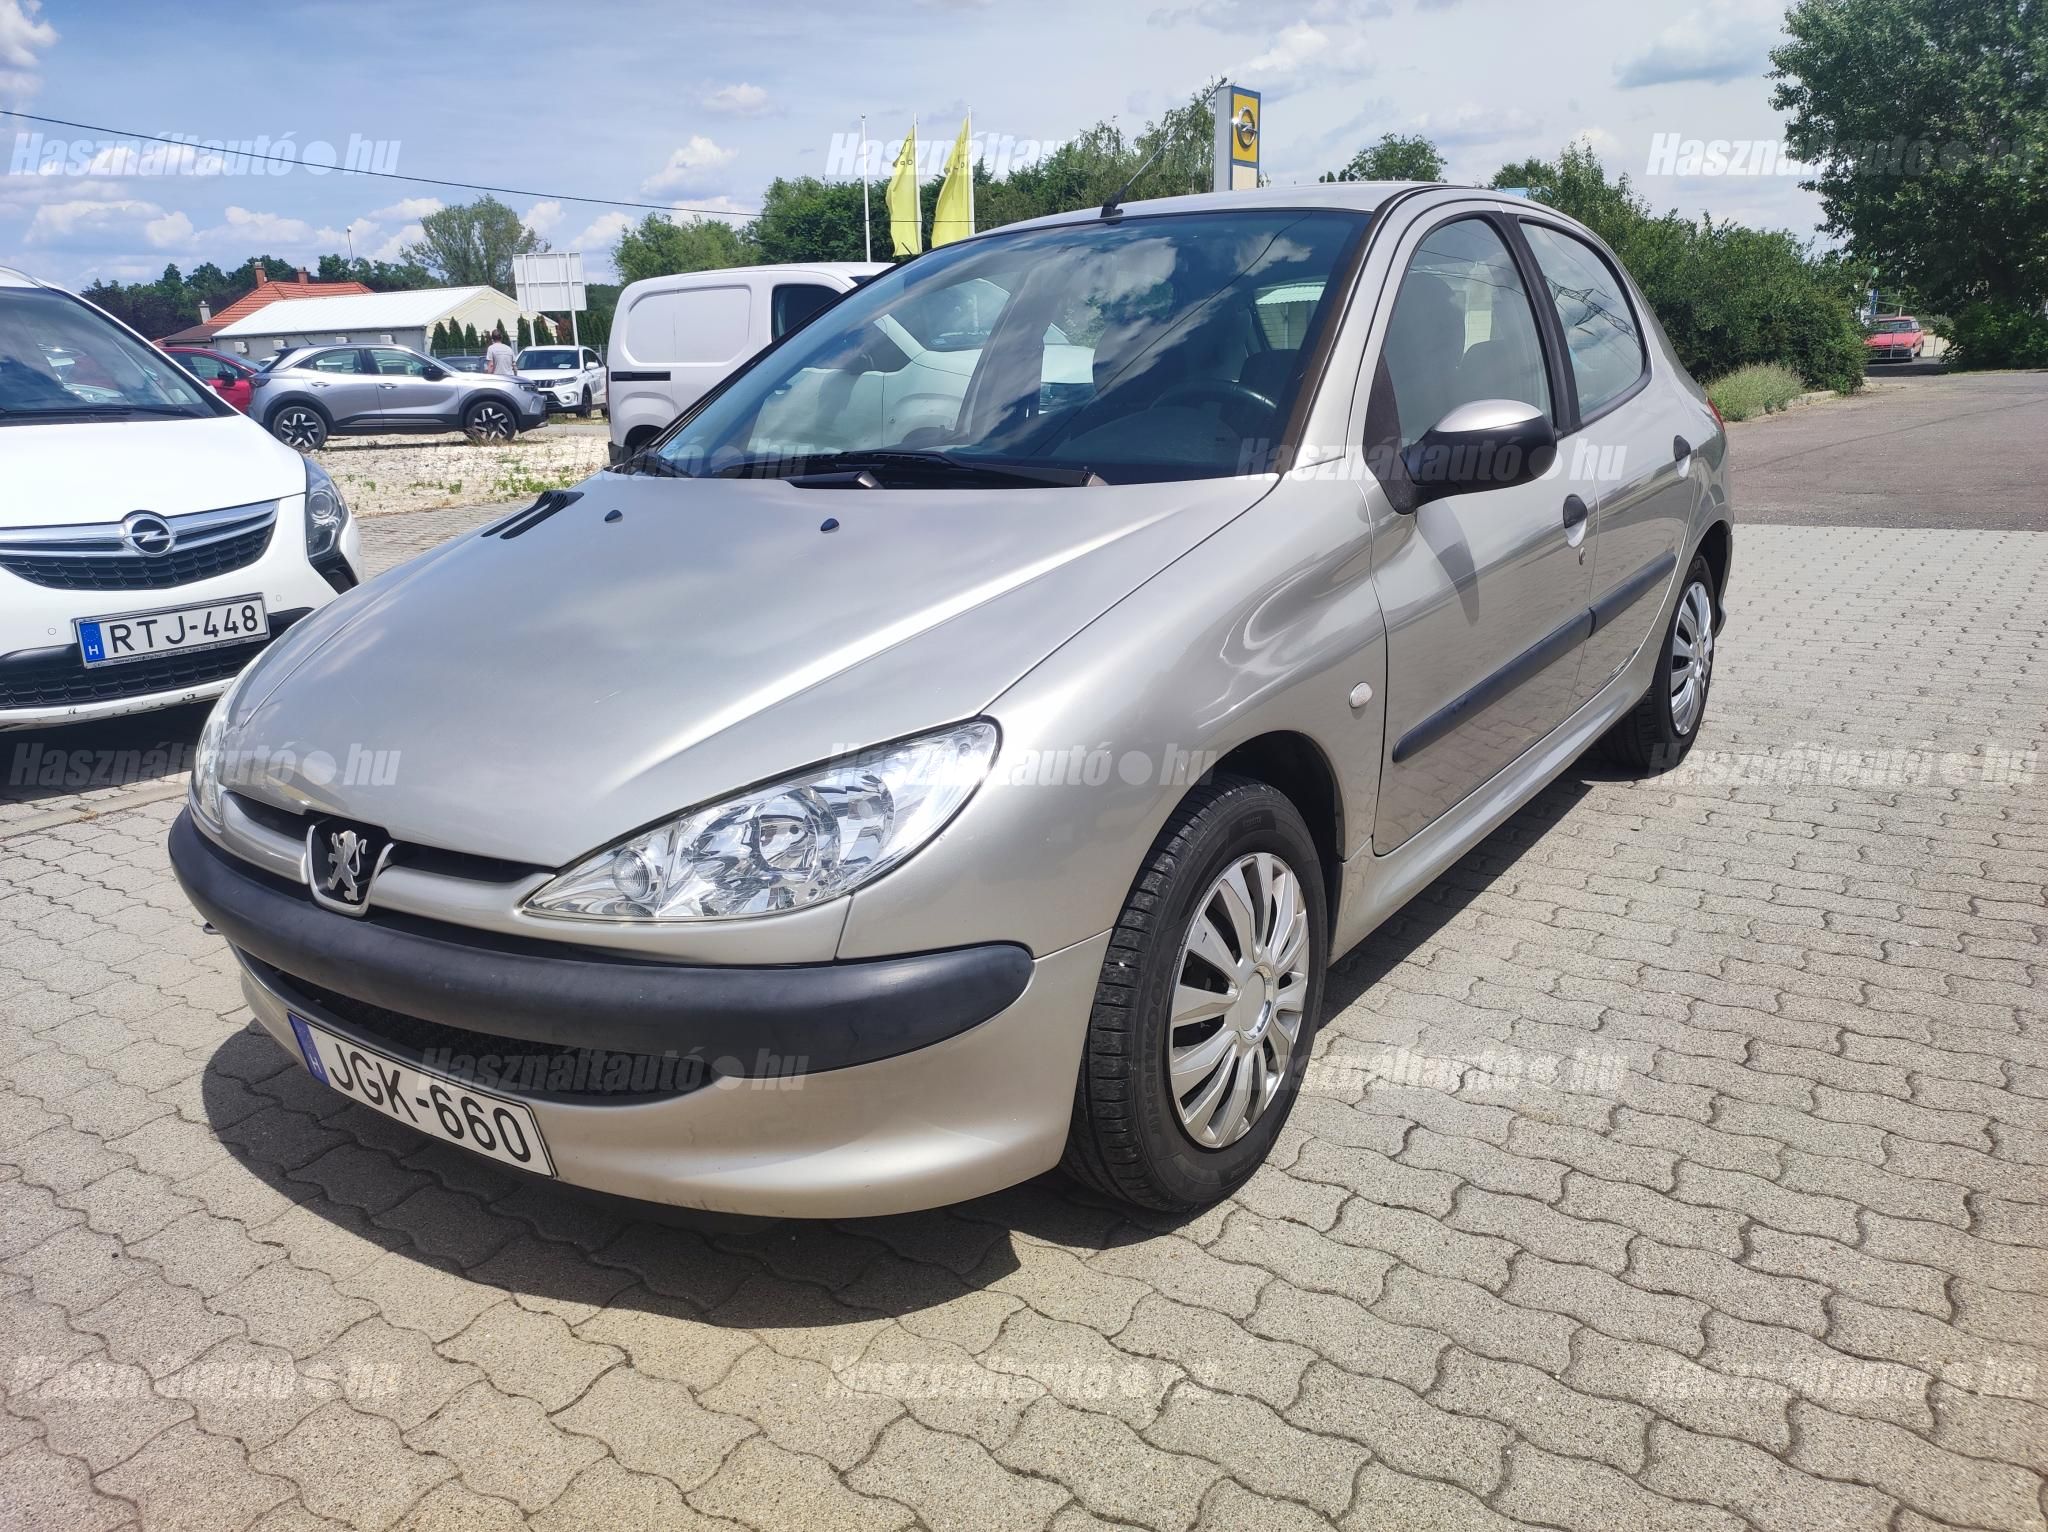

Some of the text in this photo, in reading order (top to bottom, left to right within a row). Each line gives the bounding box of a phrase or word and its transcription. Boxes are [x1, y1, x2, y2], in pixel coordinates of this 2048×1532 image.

[88, 644, 99, 656] H
[109, 604, 259, 654] RTJ-448
[308, 1043, 532, 1163] H JGK-660
